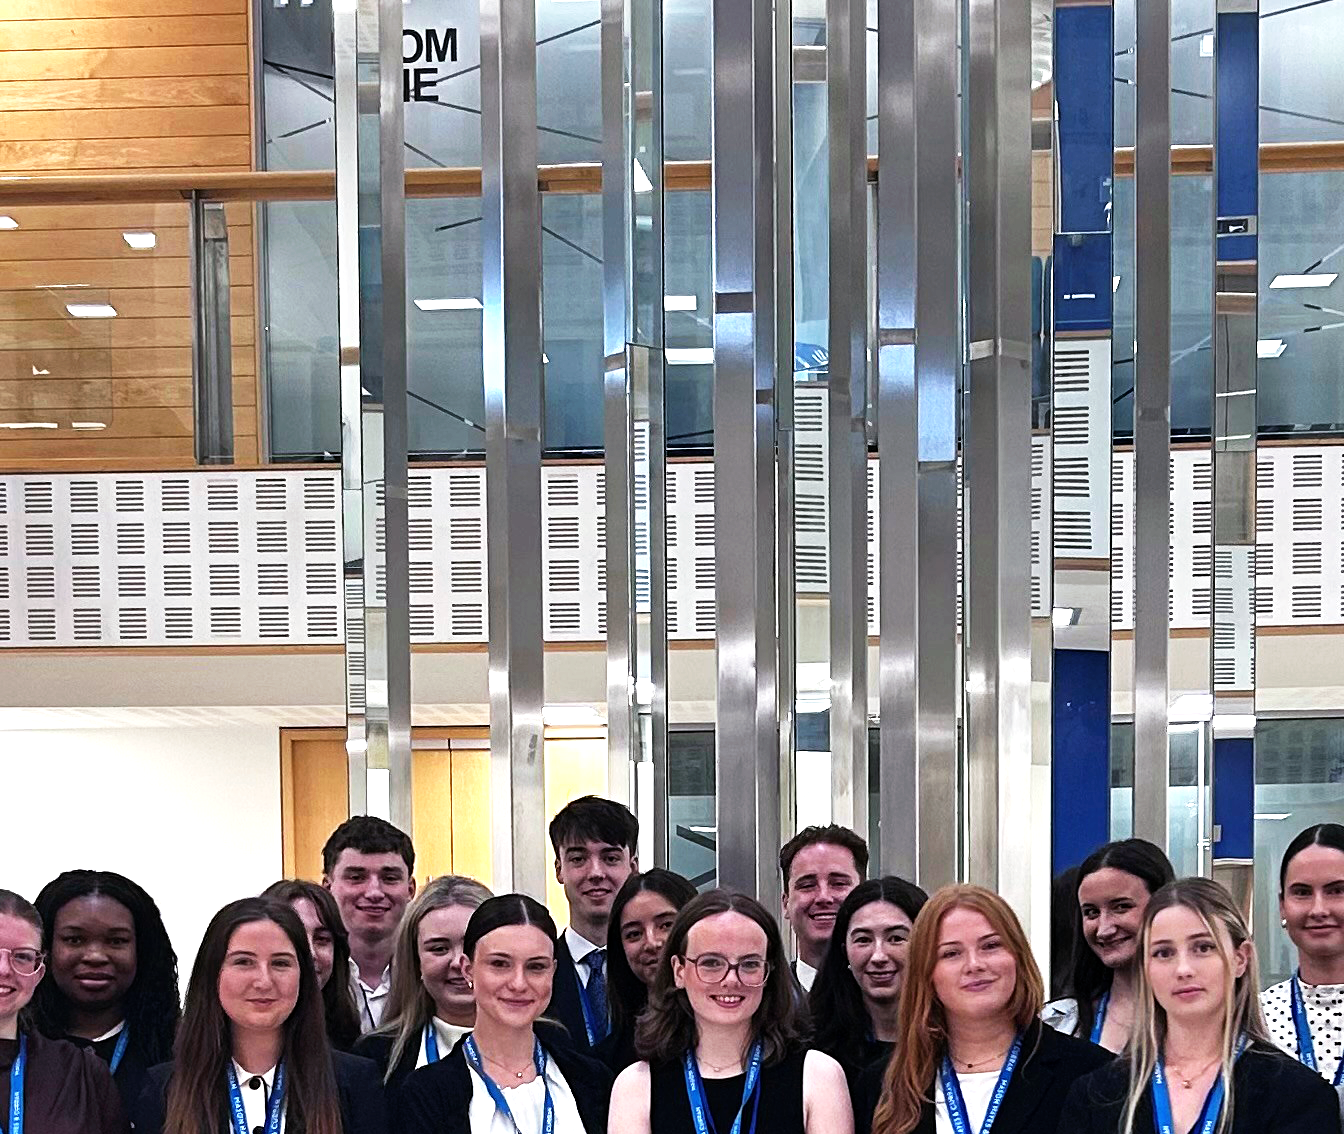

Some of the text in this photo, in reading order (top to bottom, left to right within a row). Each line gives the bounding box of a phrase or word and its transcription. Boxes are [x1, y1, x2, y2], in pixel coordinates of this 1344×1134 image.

[992, 1078, 1007, 1105] MASON
[233, 1096, 244, 1124] MASON
[984, 1104, 998, 1128] HAYES
